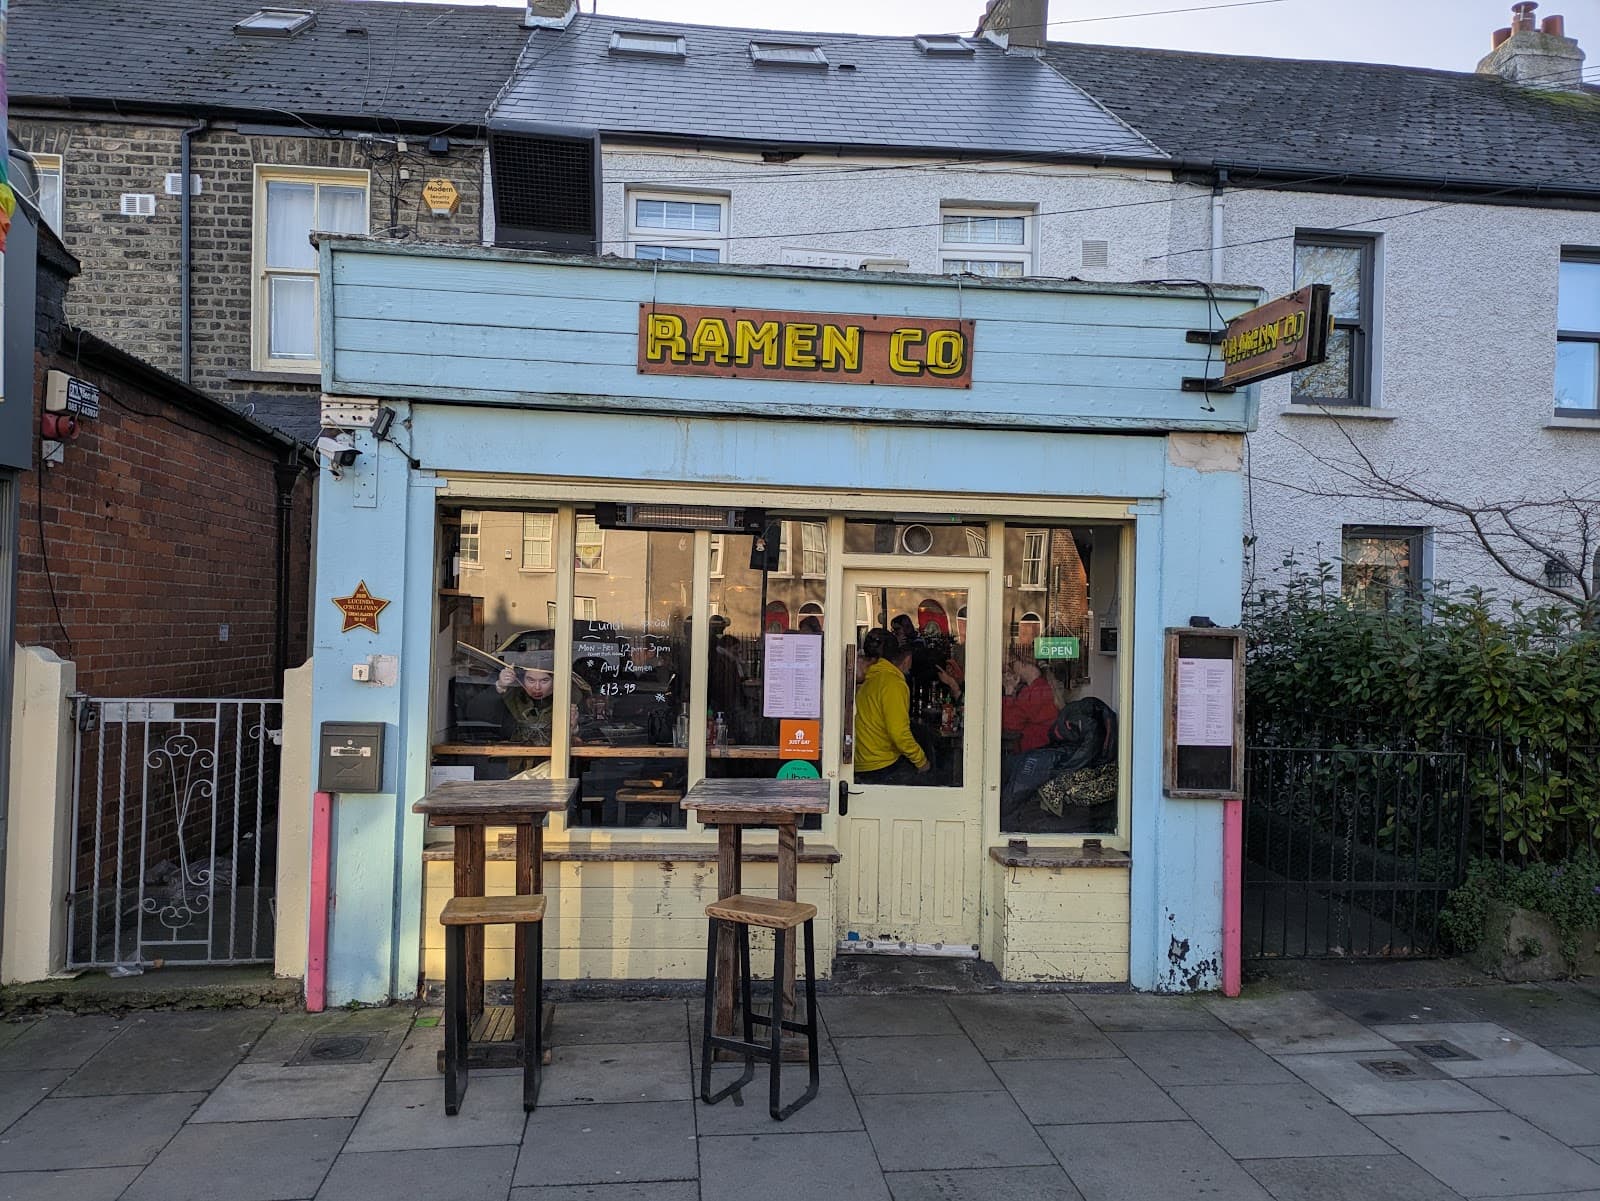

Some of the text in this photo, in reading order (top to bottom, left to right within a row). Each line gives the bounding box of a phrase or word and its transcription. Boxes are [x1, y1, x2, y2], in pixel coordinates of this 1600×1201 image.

[427, 185, 453, 193] Modern
[646, 313, 966, 376] RAMEN CO
[588, 619, 624, 632] Lunch
[1040, 645, 1073, 656] OPEN
[600, 660, 654, 678] Any Ramen
